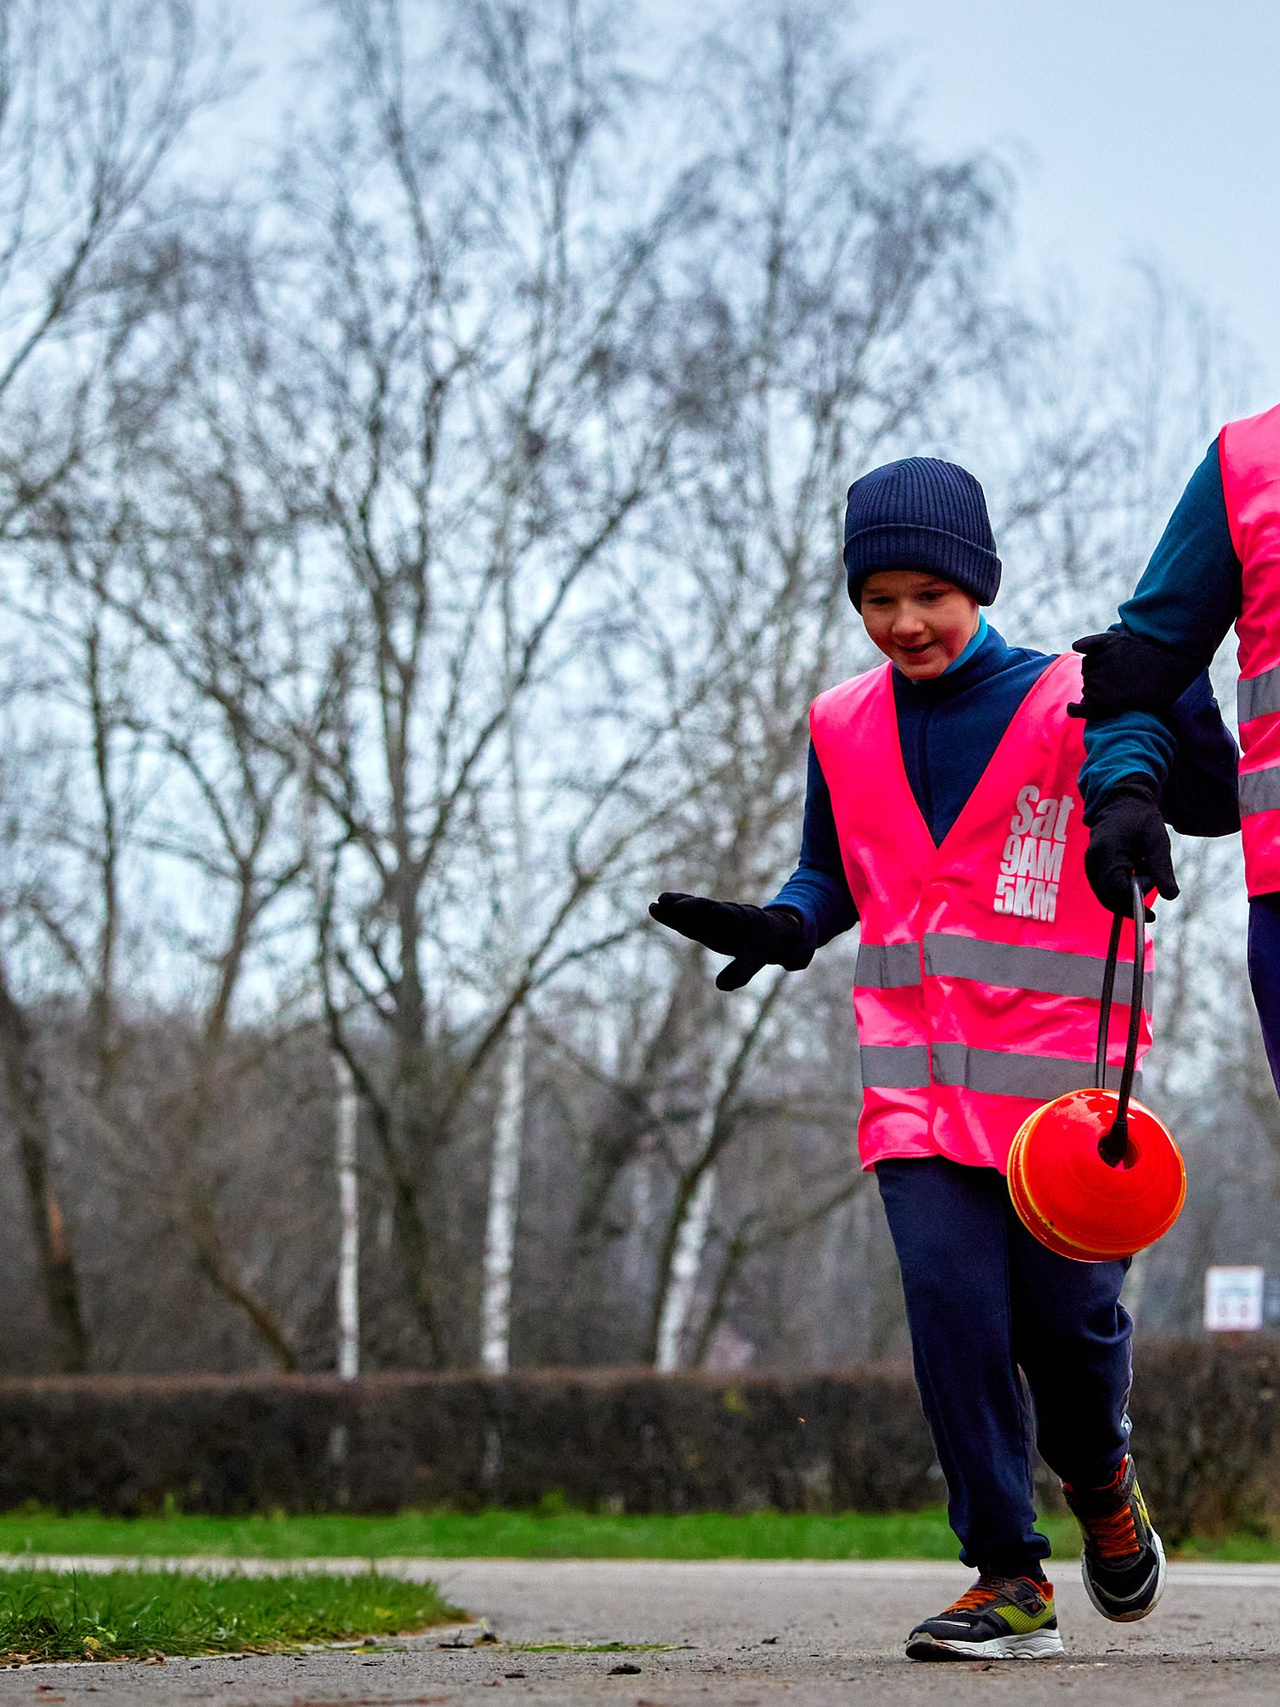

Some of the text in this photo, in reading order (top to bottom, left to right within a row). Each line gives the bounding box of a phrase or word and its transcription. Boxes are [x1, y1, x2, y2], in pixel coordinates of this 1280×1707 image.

[1010, 785, 1074, 842] Sat
[1000, 834, 1065, 882] 9AM
[994, 874, 1058, 922] 5KM
